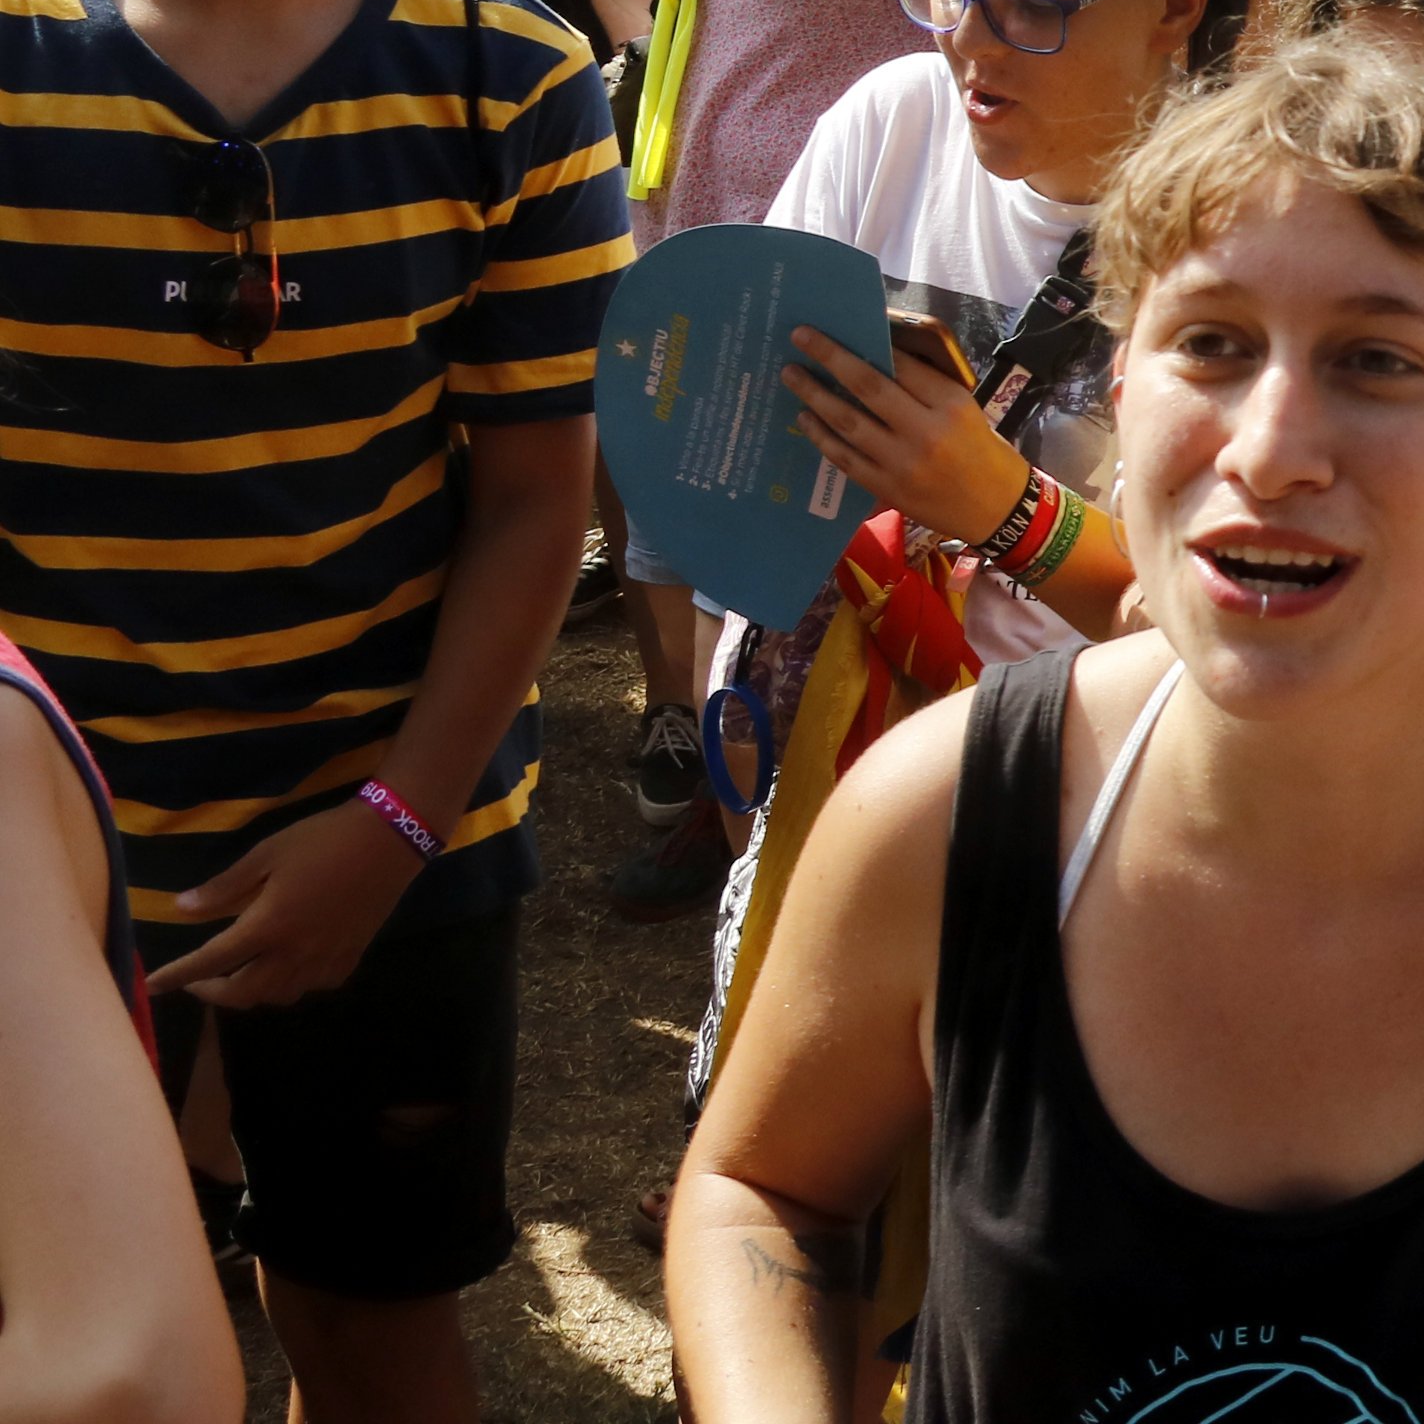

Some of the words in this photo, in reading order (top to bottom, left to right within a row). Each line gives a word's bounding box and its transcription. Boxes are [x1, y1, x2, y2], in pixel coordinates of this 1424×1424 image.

[645, 329, 669, 397] OBJECTIU
[990, 512, 1031, 551] KÖLN
[1148, 1345, 1190, 1377] LA
[1210, 1325, 1276, 1351] VEU
